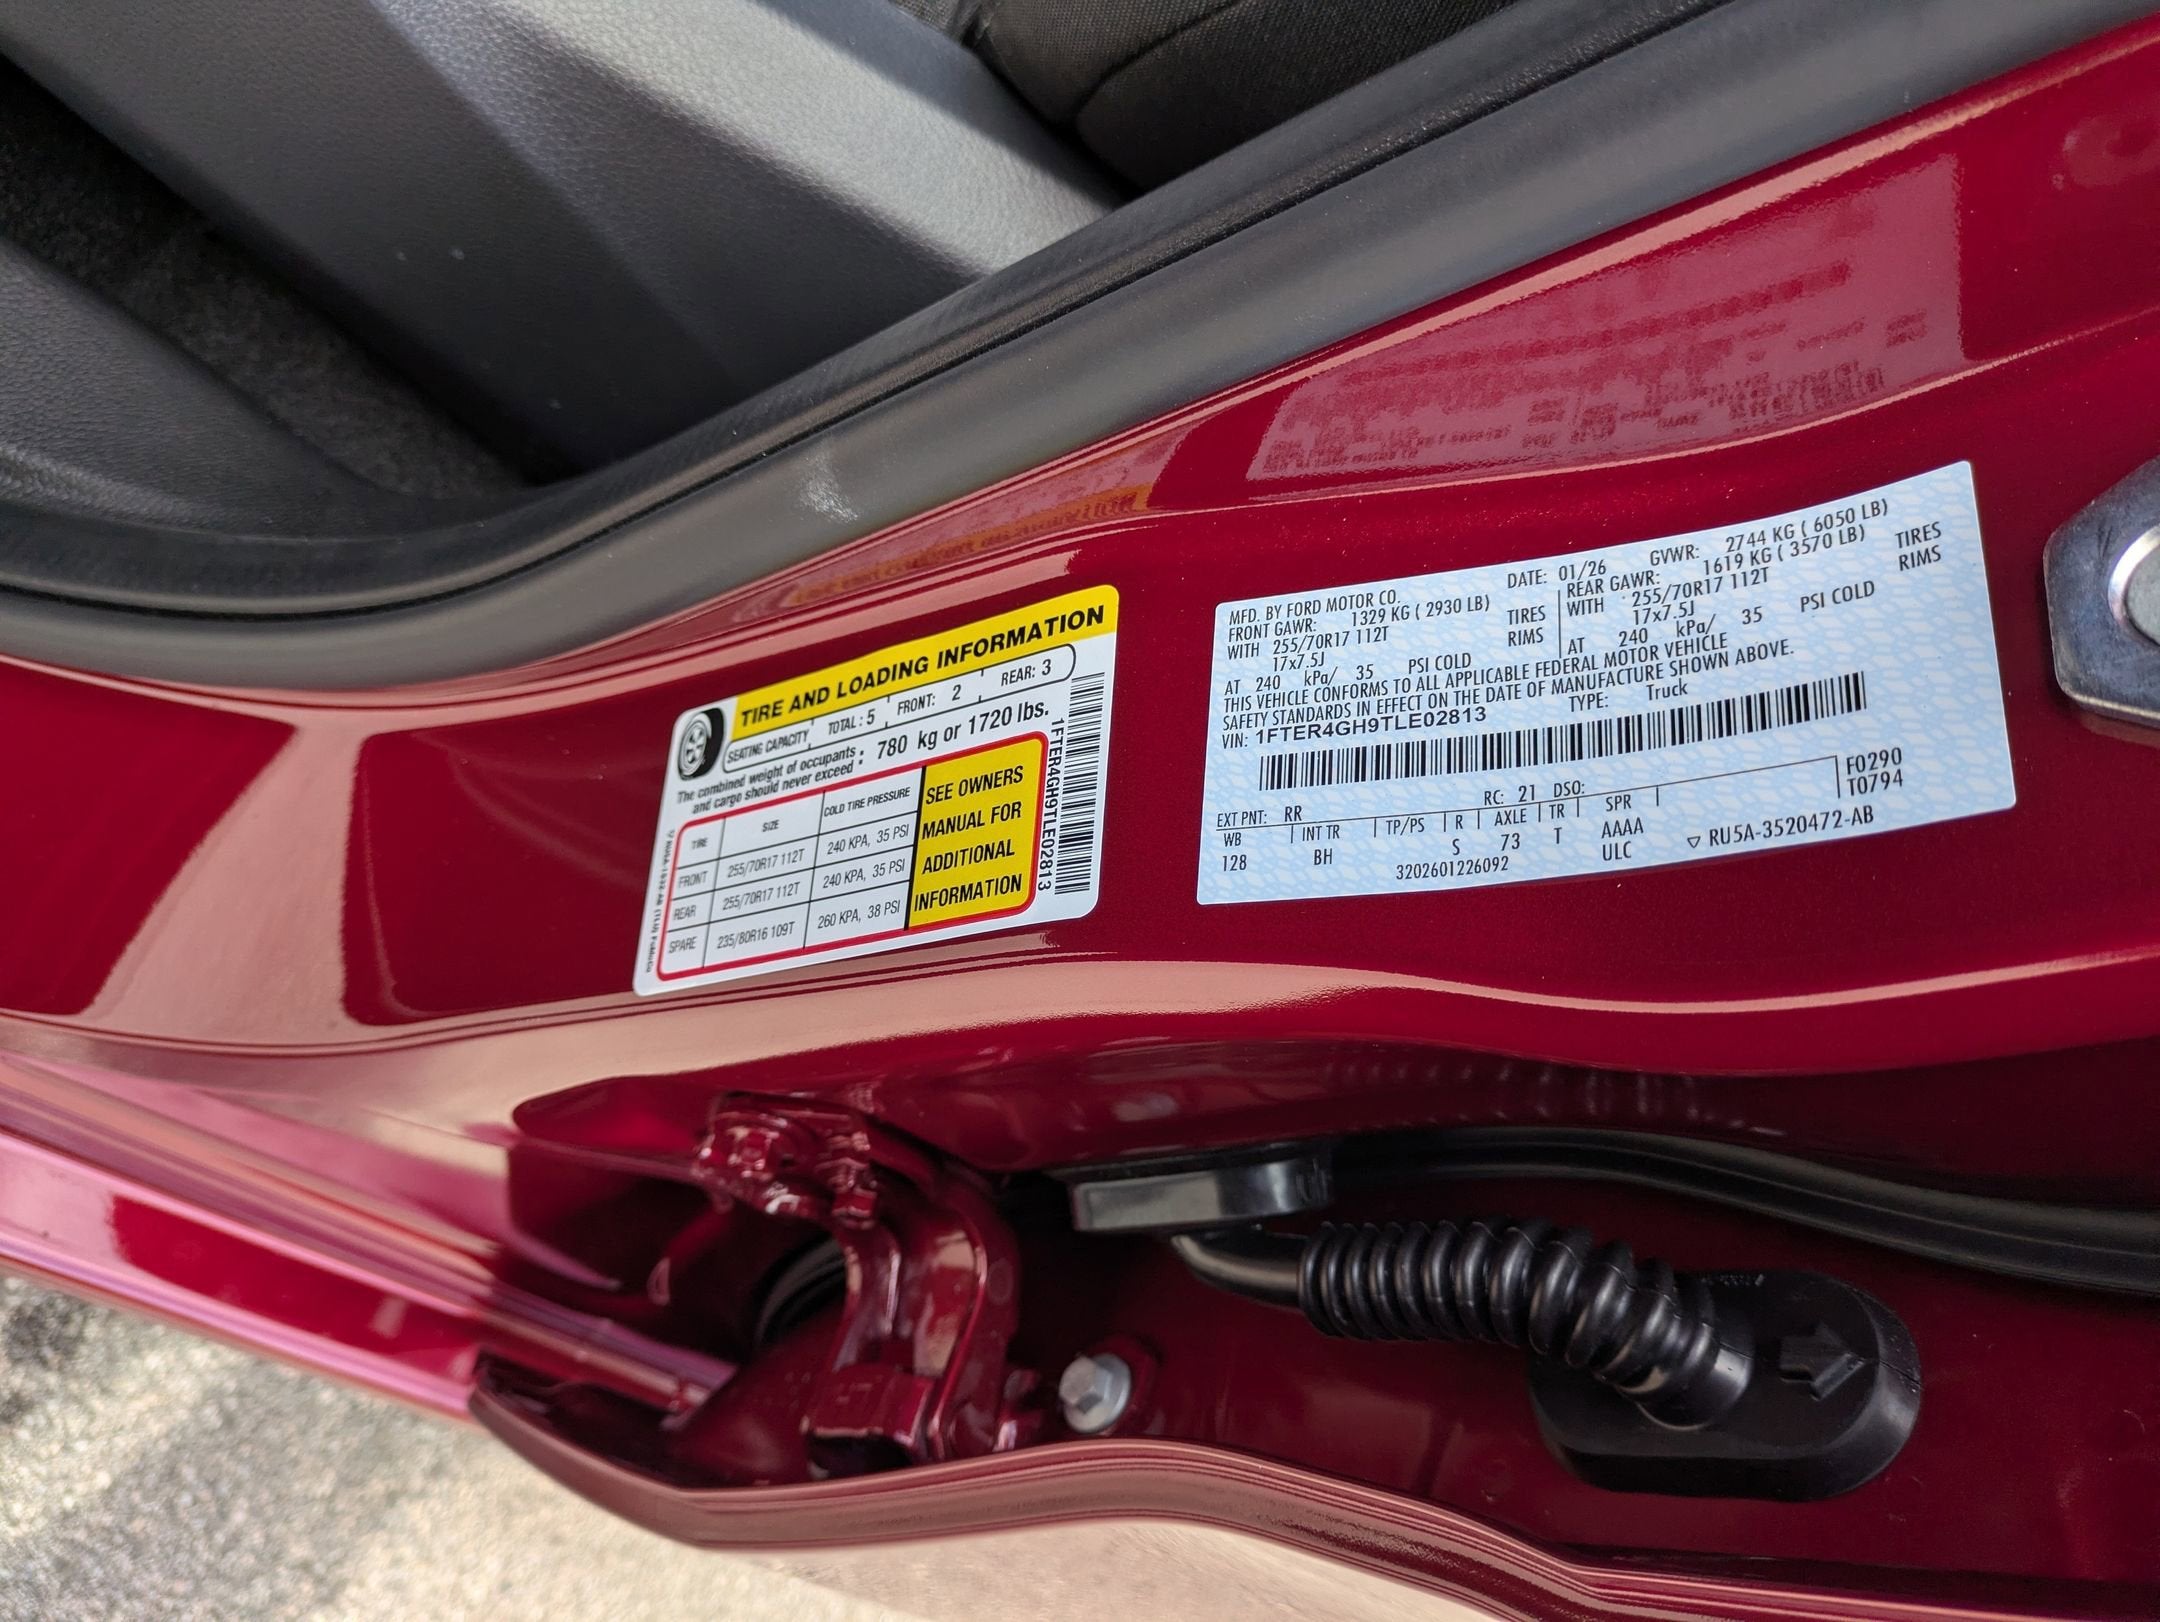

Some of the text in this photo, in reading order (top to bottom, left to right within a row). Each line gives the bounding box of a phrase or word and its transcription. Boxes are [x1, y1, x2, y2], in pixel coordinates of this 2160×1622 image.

[1650, 498, 1888, 566] GVWR: 2744 KG 6050 LB)
[1894, 521, 1942, 549] TIRES
[1567, 524, 1865, 599] REAR GAWR: 1619 KG 3570 LB)
[1898, 544, 1941, 572] RIMS
[1507, 559, 1607, 589] DATE: 01/26
[1566, 566, 1769, 617] WITH 255/70R17 112T
[1228, 594, 1490, 643] FRONT GAWR: 1329 KG 2930 LB)
[1229, 589, 1401, 626] MFD. BY FORD MOTOR CO.
[1506, 605, 1546, 625] TIRES
[1567, 580, 1875, 655] AT 240 kPa/ 35 PSI COLD
[1633, 601, 1695, 626] 17x7.5J
[1227, 625, 1390, 660] WITH 255/70R17 112T
[1508, 626, 1544, 647] RIMS
[741, 604, 1104, 727] TIRE AND LOADING INFORMATION
[1001, 658, 1052, 687] REAR: 3
[1223, 632, 1728, 713] THIS VEHICLE CONFORMS TO ALL APPLICABLE FEDERAL MOTOR VEHICLE
[1224, 652, 1472, 696] AT 240 kPa/ 35 PSI COLD
[1273, 651, 1325, 672] 17x7.5J
[1222, 638, 1794, 731] SAFETY STANDARDS IN EFFECT ON THE DATE OF MANUFACTURE SHOWN ABOVE.
[1568, 677, 1688, 713] TYPE: Truck
[897, 684, 962, 716] FRONT: 2
[866, 708, 876, 725] 5
[877, 701, 1049, 760] 780 kg or 1720 lbs.
[1221, 703, 1487, 750] VIN: 1FTER4GH9TLE02813
[727, 729, 809, 764] SEATING CAPACITY
[697, 746, 856, 798] combined weight of occupants
[782, 759, 854, 791] never exceed
[1846, 747, 1902, 776] F0290
[925, 765, 1024, 805] SEE OWNERS
[1484, 780, 1585, 806] RC: 21 DSO:
[1847, 768, 1903, 796] T0794
[824, 786, 911, 817] COLD TIRE PRESSURE
[1037, 717, 1065, 891] 1FTER4GH9TLE02813
[1548, 803, 1565, 820] TR
[1605, 794, 1632, 812] SPR
[921, 801, 1022, 840] MANUAL FOR
[1217, 805, 1303, 828] EXT PNT: RR
[1385, 817, 1425, 835] TP/PS
[1455, 814, 1464, 830] R
[1494, 807, 1527, 827] AXLE
[1601, 816, 1644, 839] AAAA
[1709, 805, 1874, 847] RU5A-3520472-AB
[827, 823, 910, 855] 240 KPA, 35 PSI
[1223, 831, 1242, 848] WB
[1302, 824, 1340, 842] INT TR
[1452, 838, 1460, 856] S
[1500, 832, 1520, 852] 73
[1553, 827, 1562, 845] T
[727, 848, 805, 878] 255/70R17 112T
[921, 838, 1015, 875] ADDITIONAL
[1222, 854, 1247, 872] 128
[1313, 848, 1333, 866] BH
[1602, 840, 1632, 861] ULC
[822, 858, 905, 889] 240 KPA, 35 PSI
[1395, 855, 1509, 880] 3202601226092
[722, 881, 800, 910] 255/70R17 112T
[914, 873, 1022, 912] INFORMATION
[674, 905, 696, 920] REAR
[817, 899, 901, 929] 260 KPA, 38 PSI
[669, 936, 697, 953] SPARE
[717, 921, 795, 949] 235/80R16 109T
